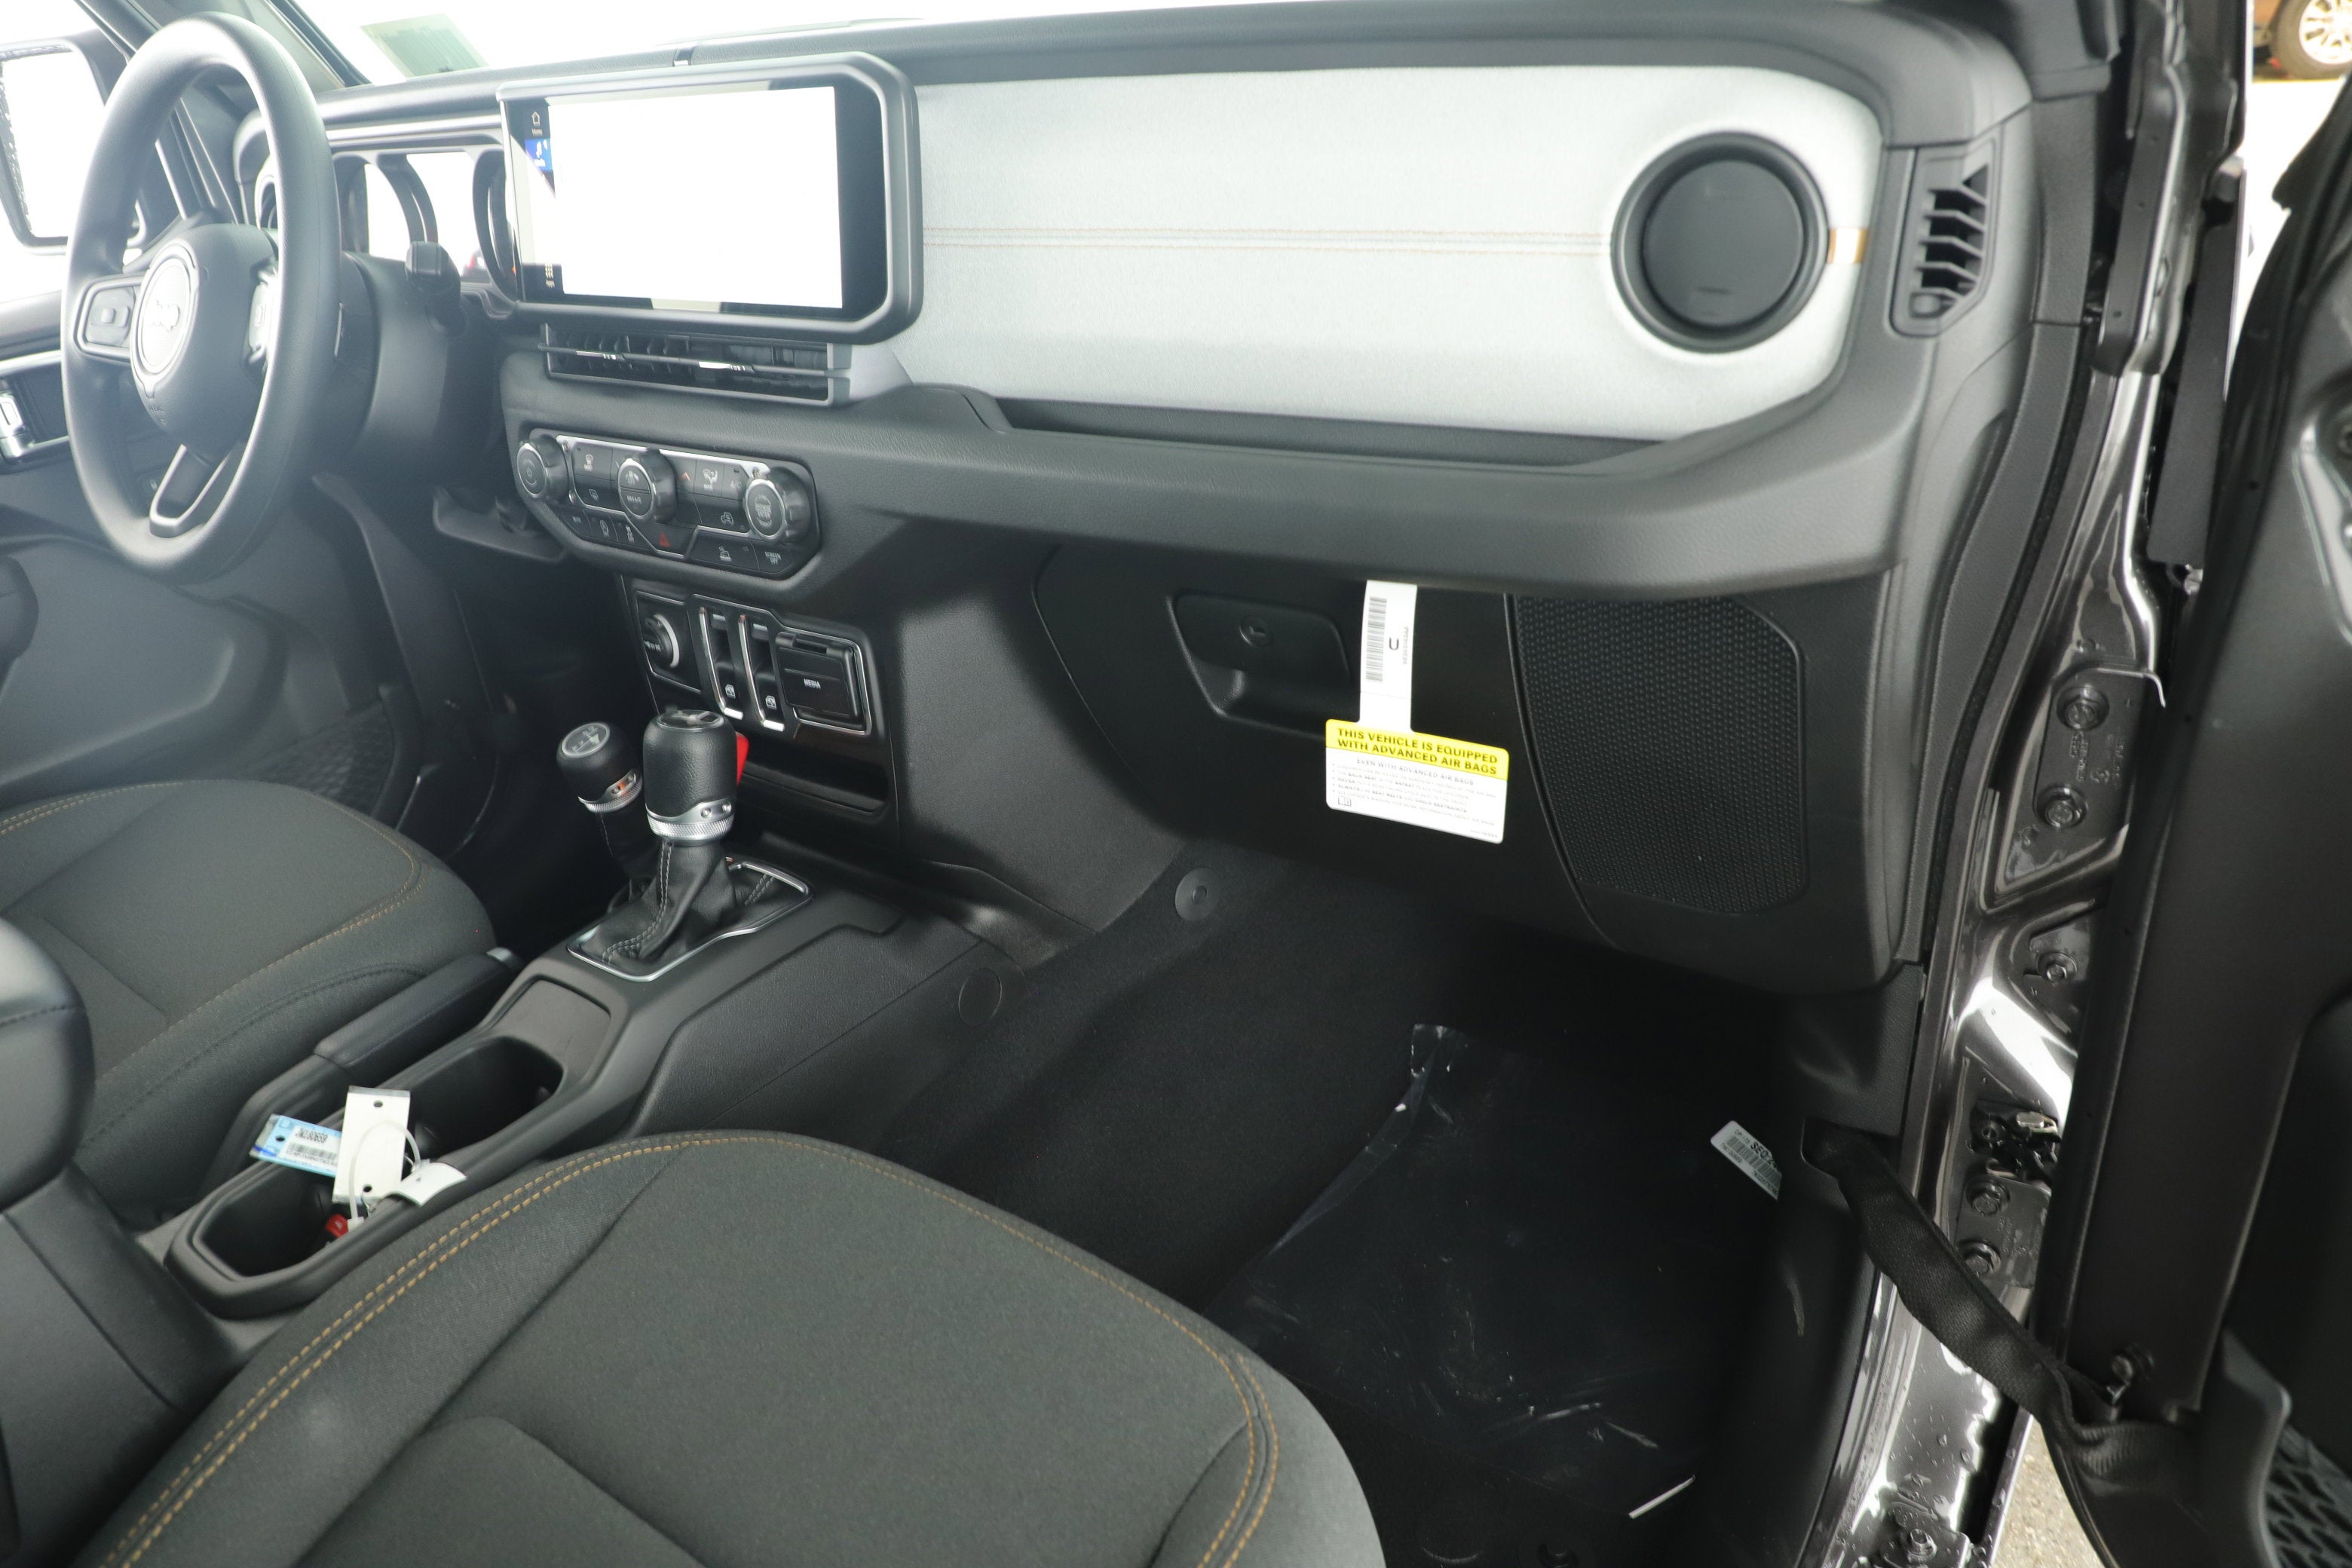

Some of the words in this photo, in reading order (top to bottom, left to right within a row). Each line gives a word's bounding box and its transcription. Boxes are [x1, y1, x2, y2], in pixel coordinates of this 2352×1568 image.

[803, 678, 822, 690] MEDIA
[1337, 727, 1364, 740] THIS
[1368, 733, 1418, 749] VEHICLE
[1422, 741, 1433, 751] IS
[1436, 744, 1498, 764] EQUIPPED
[1337, 738, 1368, 751] WITH
[1372, 743, 1438, 763] ADVANCED
[1441, 757, 1460, 768] AIR
[1465, 761, 1496, 775] BAGS
[1357, 758, 1376, 767] EVEN
[1378, 761, 1396, 770] WITH
[1398, 765, 1438, 778] ADVANCED
[1454, 775, 1474, 786] BAGS
